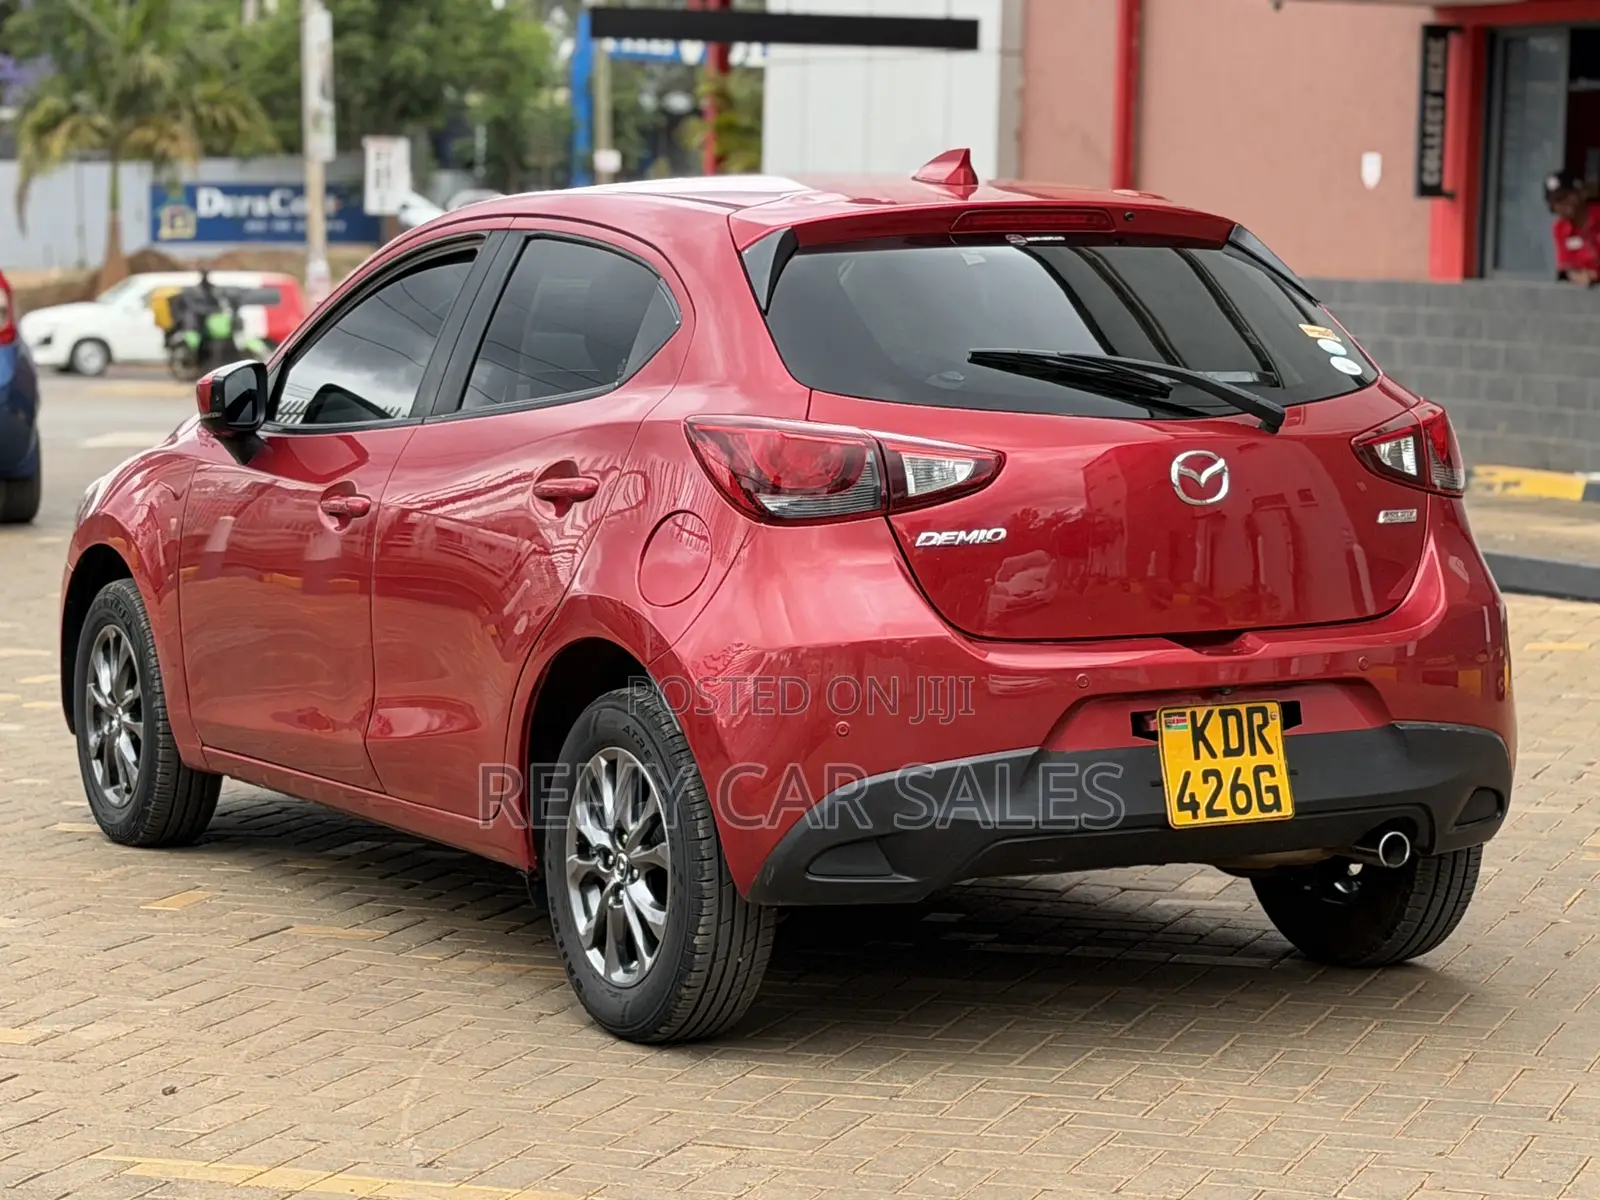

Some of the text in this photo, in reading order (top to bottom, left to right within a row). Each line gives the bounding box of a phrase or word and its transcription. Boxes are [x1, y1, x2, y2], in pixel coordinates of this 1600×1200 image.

[915, 527, 1007, 547] DEMIO
[1189, 705, 1274, 761] KDR
[1176, 764, 1283, 820] 426G
